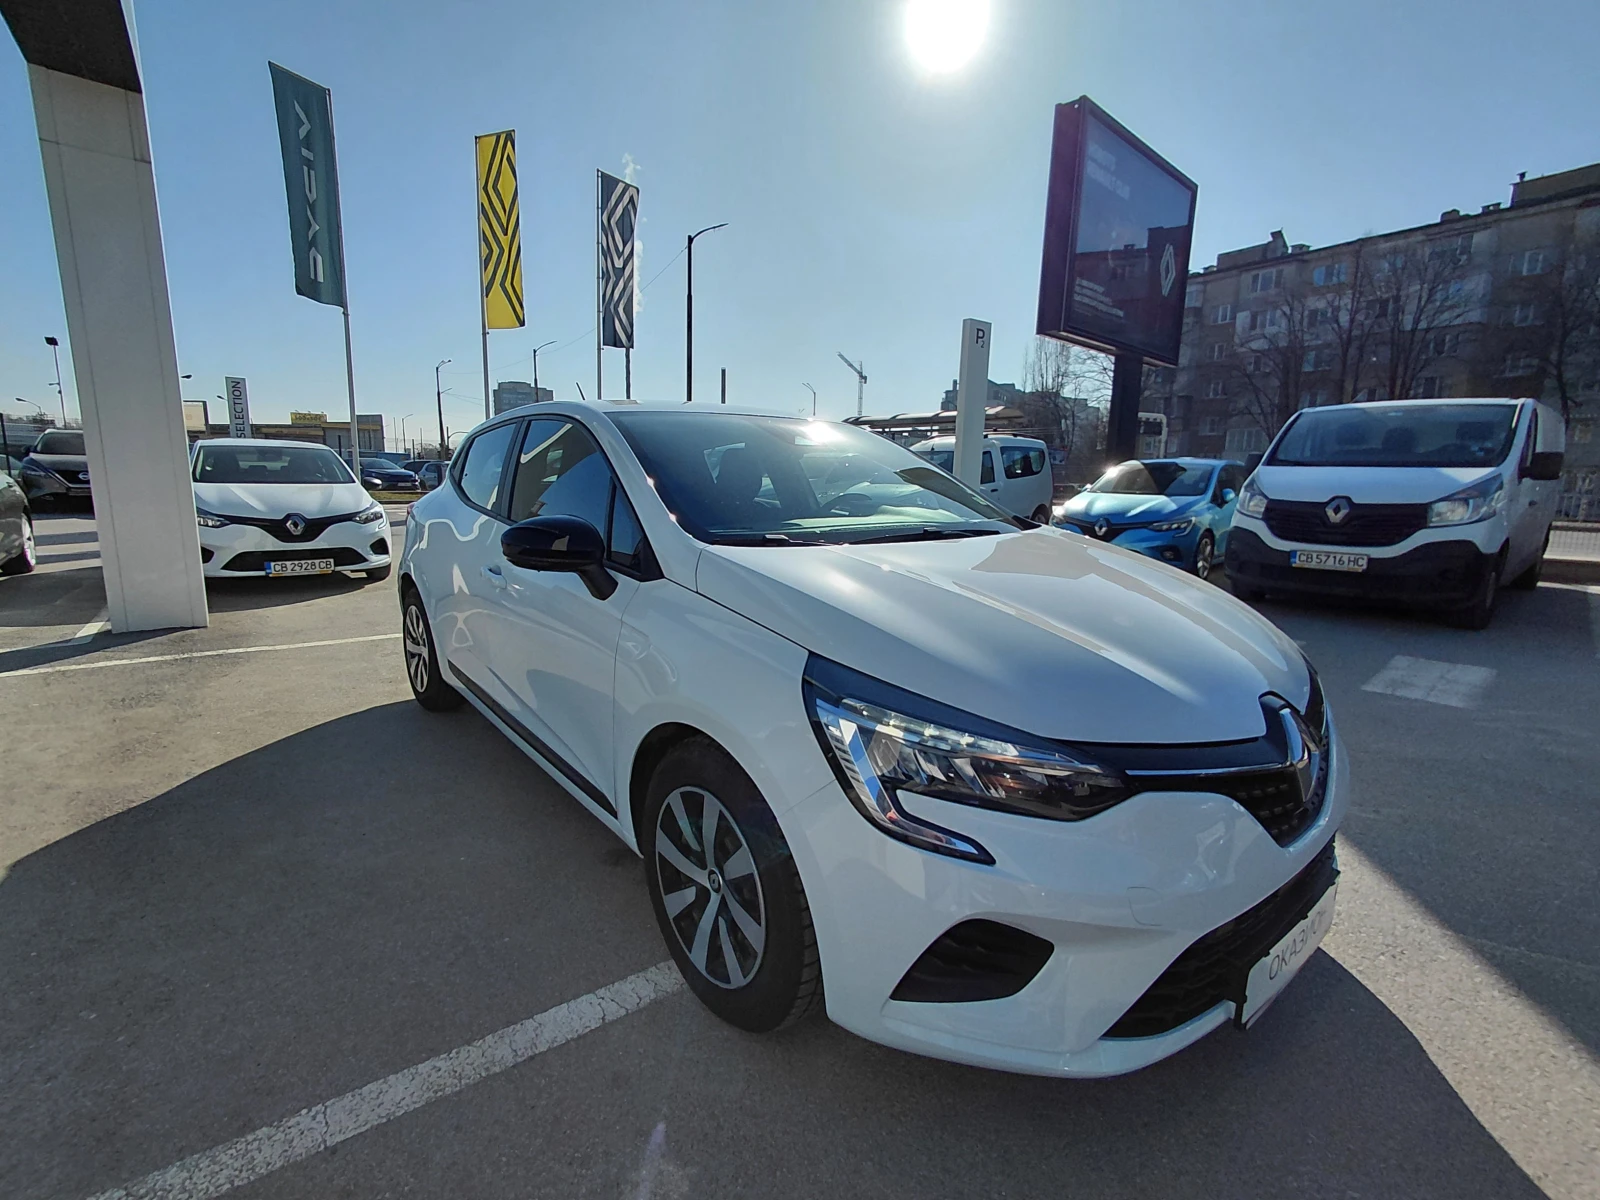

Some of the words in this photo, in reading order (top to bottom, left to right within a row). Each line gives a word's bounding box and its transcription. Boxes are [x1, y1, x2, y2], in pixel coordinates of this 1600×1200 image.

[230, 380, 247, 438] SELECTION
[273, 562, 288, 573] CB
[290, 561, 317, 572] 2928
[318, 560, 333, 570] CB
[1298, 552, 1313, 564] CB
[1315, 553, 1345, 566] 5716
[1347, 555, 1365, 568] HC
